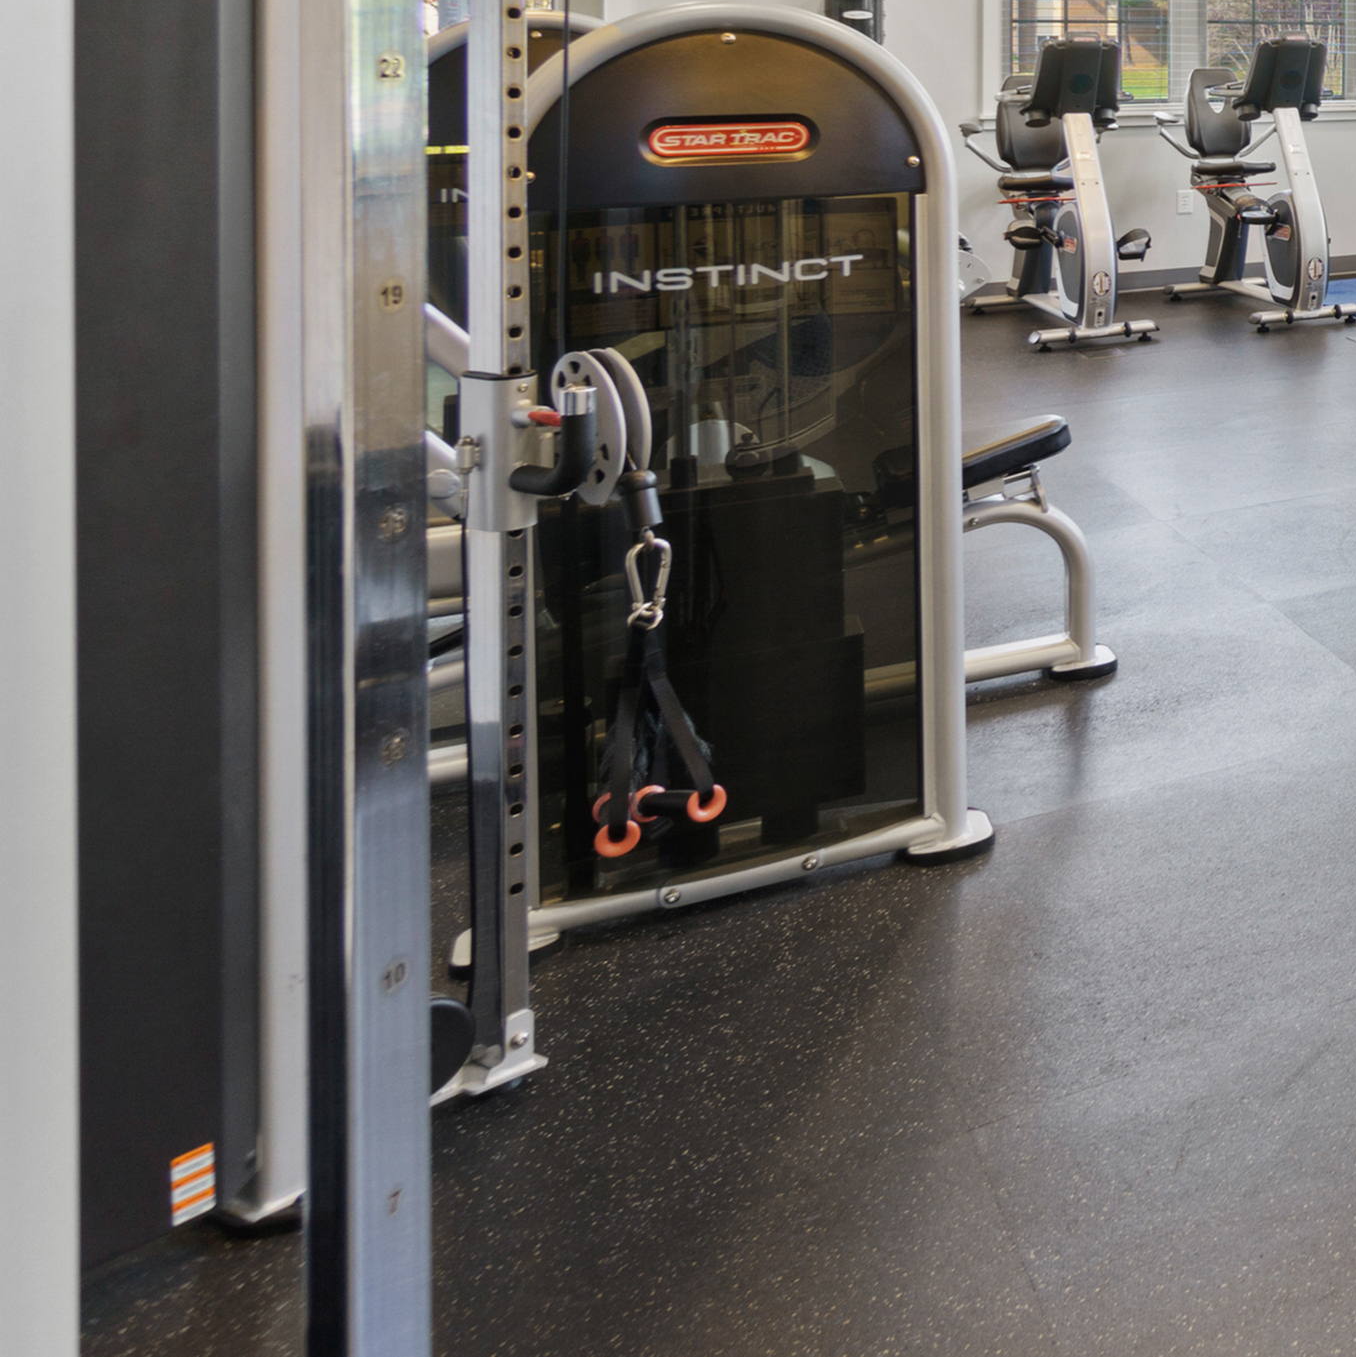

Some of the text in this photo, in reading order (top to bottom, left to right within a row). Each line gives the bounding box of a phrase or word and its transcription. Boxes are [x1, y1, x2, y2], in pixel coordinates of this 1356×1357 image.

[379, 57, 402, 80] 22
[662, 131, 796, 147] STAR TRAC
[593, 254, 864, 294] INSTINCT
[380, 285, 404, 307] 19
[382, 961, 407, 992] 10
